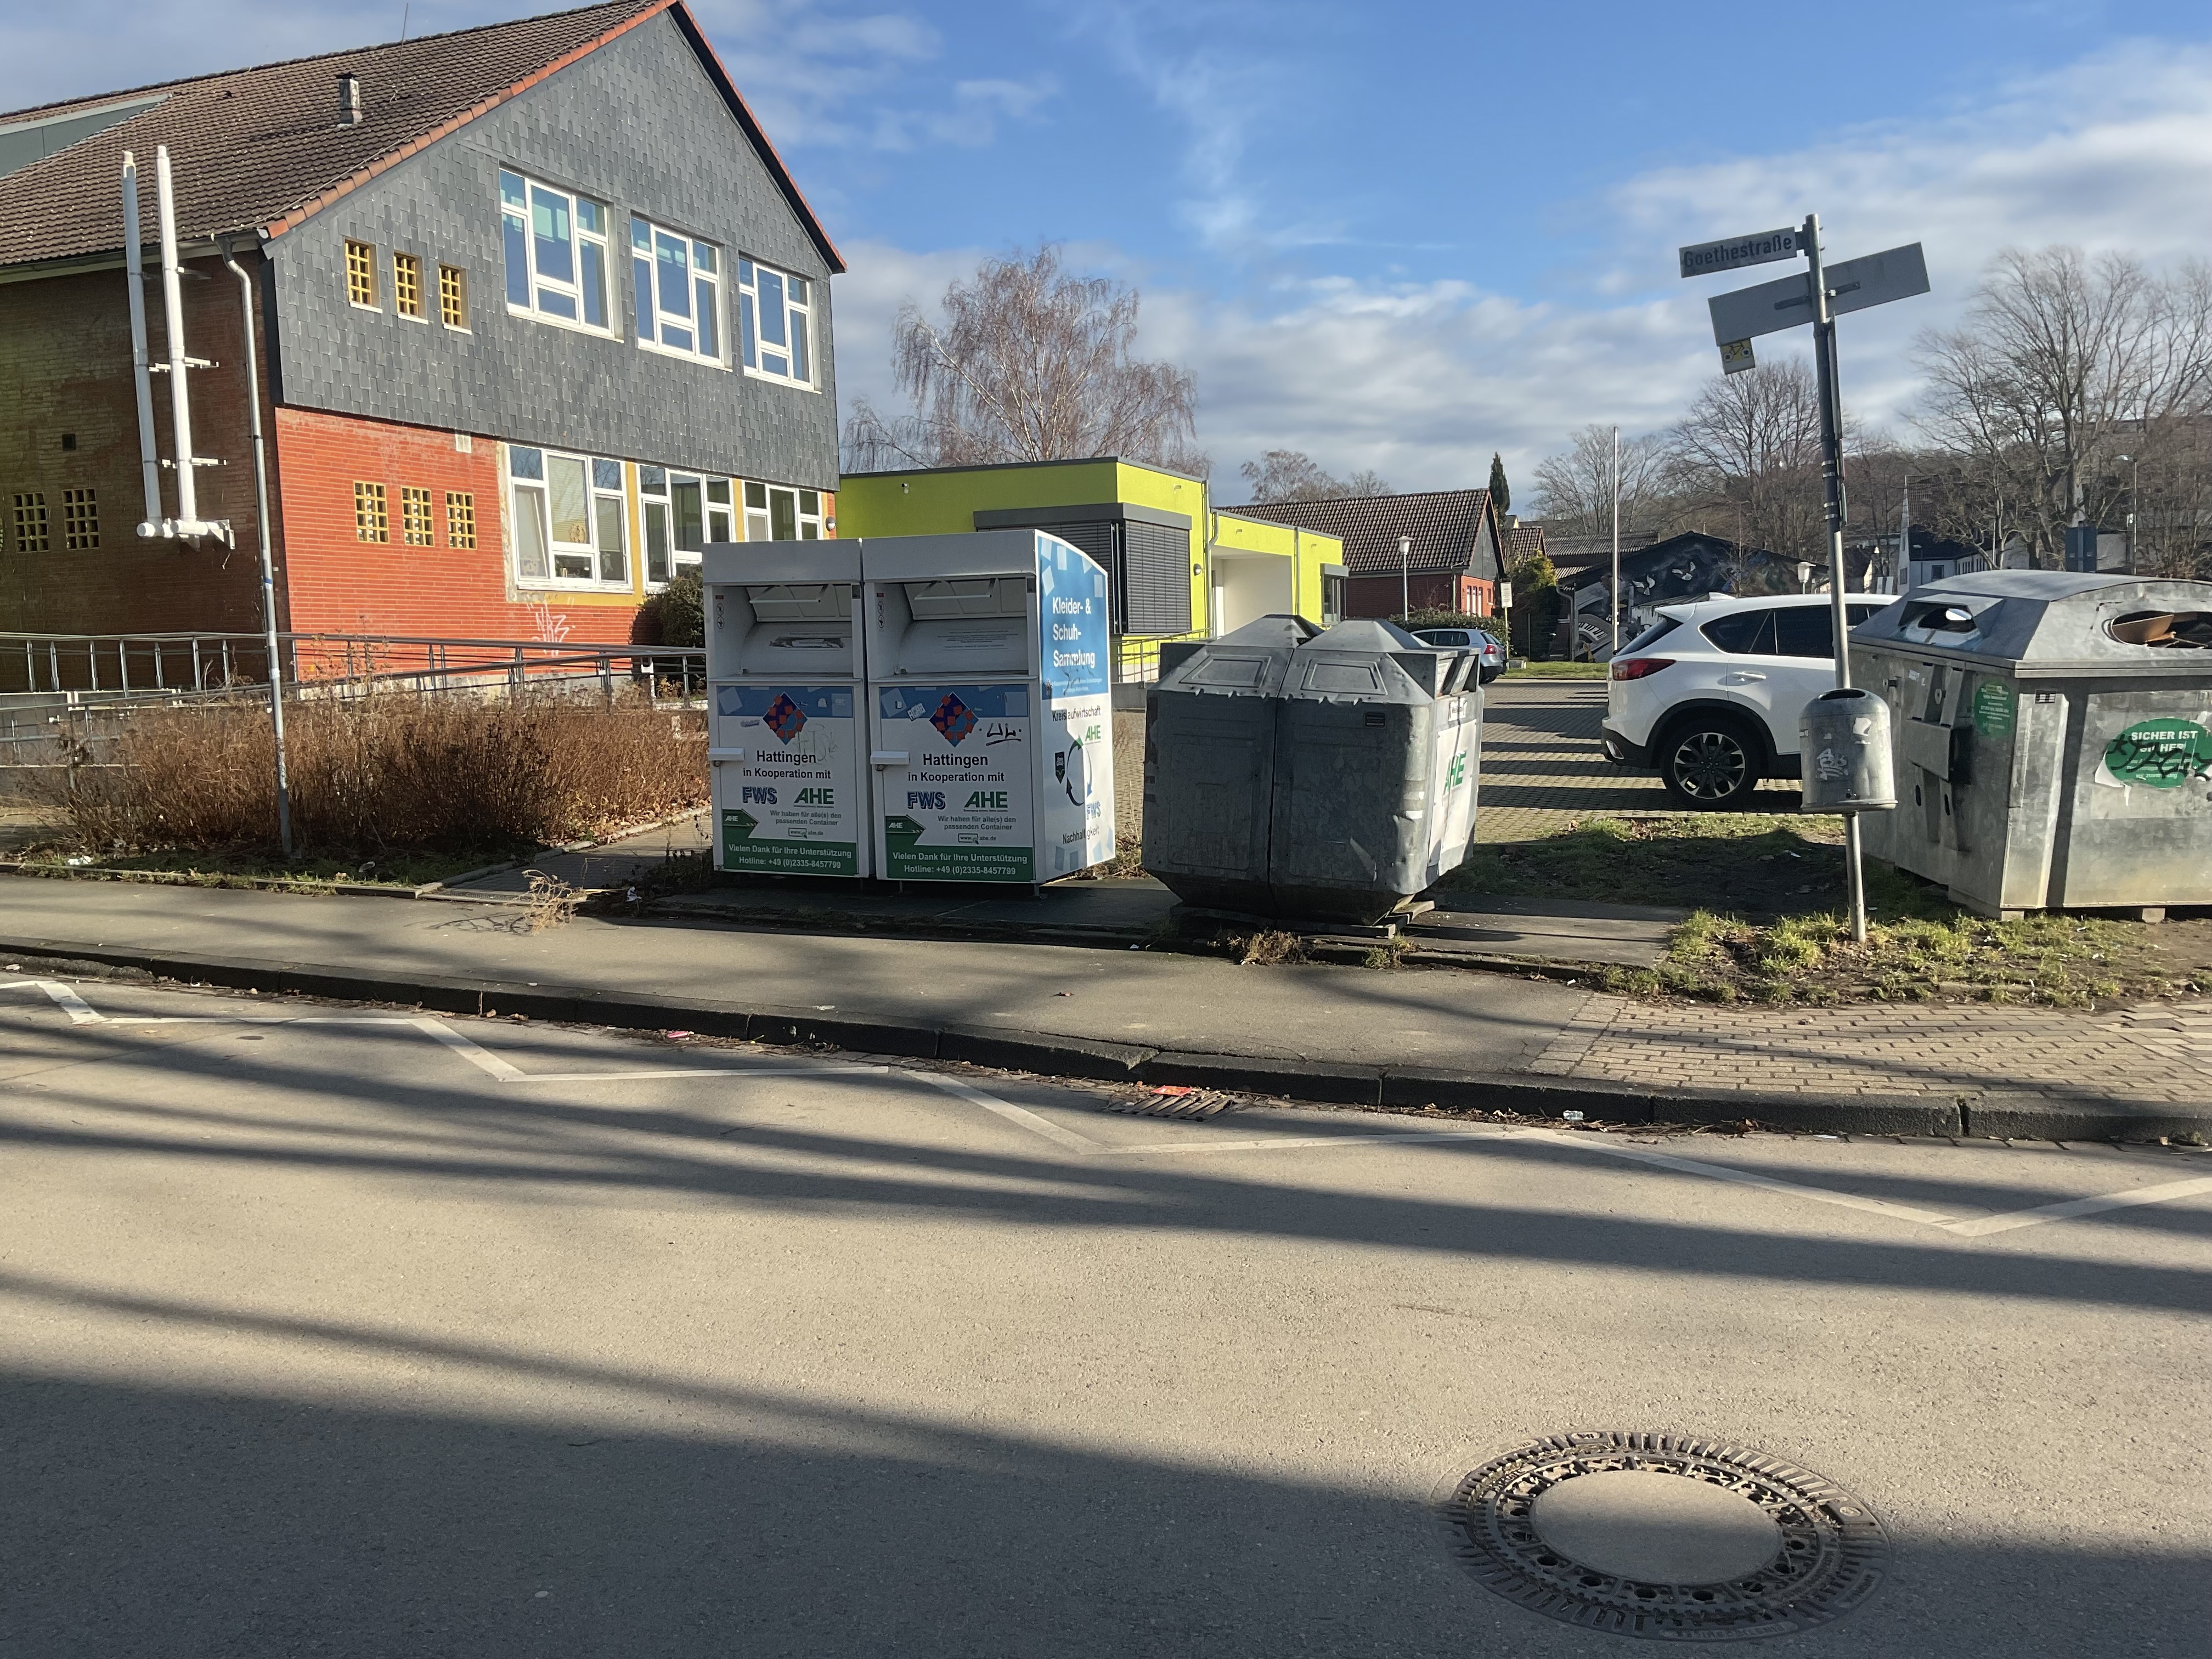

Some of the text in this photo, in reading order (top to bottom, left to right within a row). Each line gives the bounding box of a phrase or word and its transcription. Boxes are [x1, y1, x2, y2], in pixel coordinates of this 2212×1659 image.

[1684, 234, 1792, 267] Goethestraße
[1053, 597, 1091, 614] Kleider- &
[1053, 623, 1081, 641] Schuh-
[1053, 649, 1095, 669] Sammlung
[1052, 705, 1101, 722] Kreislaufwirtschaft
[1085, 724, 1101, 741] AHE
[2131, 731, 2198, 741] SICHER IST
[757, 750, 816, 766] Hattingen
[923, 753, 988, 768] Hattingen
[743, 768, 831, 780] in Kooperation mit
[908, 771, 1005, 783] in Kooperation mit
[1443, 749, 1467, 796] AHE
[742, 786, 777, 804] FWS
[794, 787, 834, 805] AHE
[907, 790, 946, 810] FWS
[964, 791, 1008, 808] AHE
[1086, 800, 1101, 820] FWS
[1063, 825, 1099, 844] Nachhaltigkeit
[729, 844, 751, 852] Vielen
[752, 845, 770, 853] Dank
[800, 847, 851, 859] Unterstützung
[893, 852, 916, 860] Vielen
[918, 853, 938, 861] Dank
[953, 853, 968, 861] Ihre
[971, 854, 1027, 864] Unterstützung
[739, 856, 841, 868] Hotline: +49 (0)2335-8457799
[904, 864, 1015, 875] Hotline: +49 (0)2335-8457799
